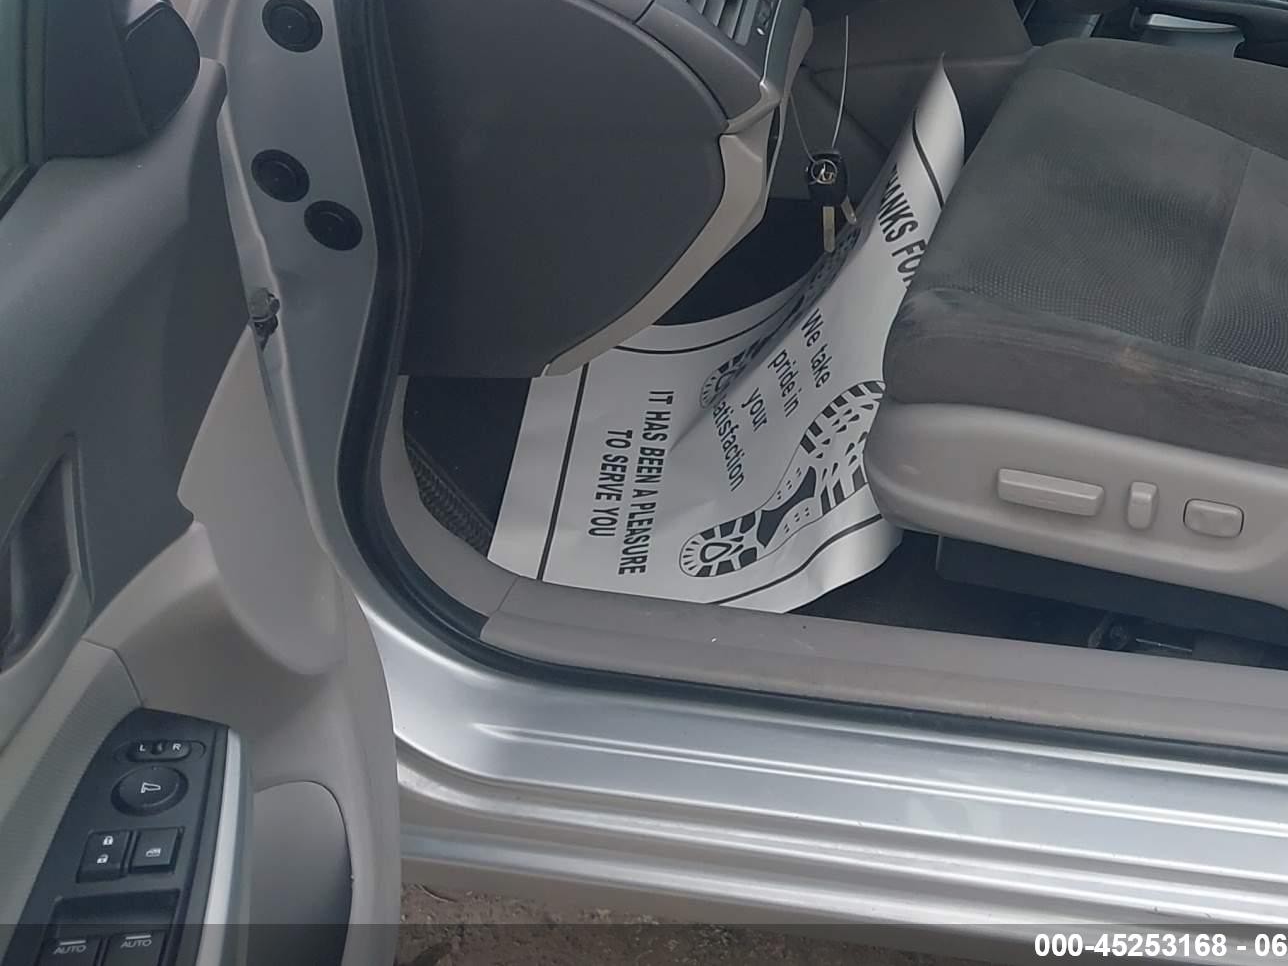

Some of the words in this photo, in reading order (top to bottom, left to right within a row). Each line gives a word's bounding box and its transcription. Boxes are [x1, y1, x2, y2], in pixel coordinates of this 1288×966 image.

[891, 239, 926, 282] FO
[801, 308, 823, 347] We
[768, 349, 799, 397] pride
[784, 388, 802, 418] in
[811, 344, 832, 388] take
[648, 391, 674, 405] IT
[741, 387, 767, 431] your
[605, 430, 633, 449] TO
[642, 411, 671, 441] HAS
[713, 400, 744, 491] atisfaction
[595, 454, 629, 501] SERVE
[634, 447, 666, 483] BEEN
[632, 489, 658, 498] A
[588, 507, 620, 536] YOU
[618, 502, 656, 575] PLEASURE
[140, 744, 147, 752] L
[172, 743, 181, 751] R
[53, 944, 87, 955] AUTO
[120, 939, 152, 949] AUTO
